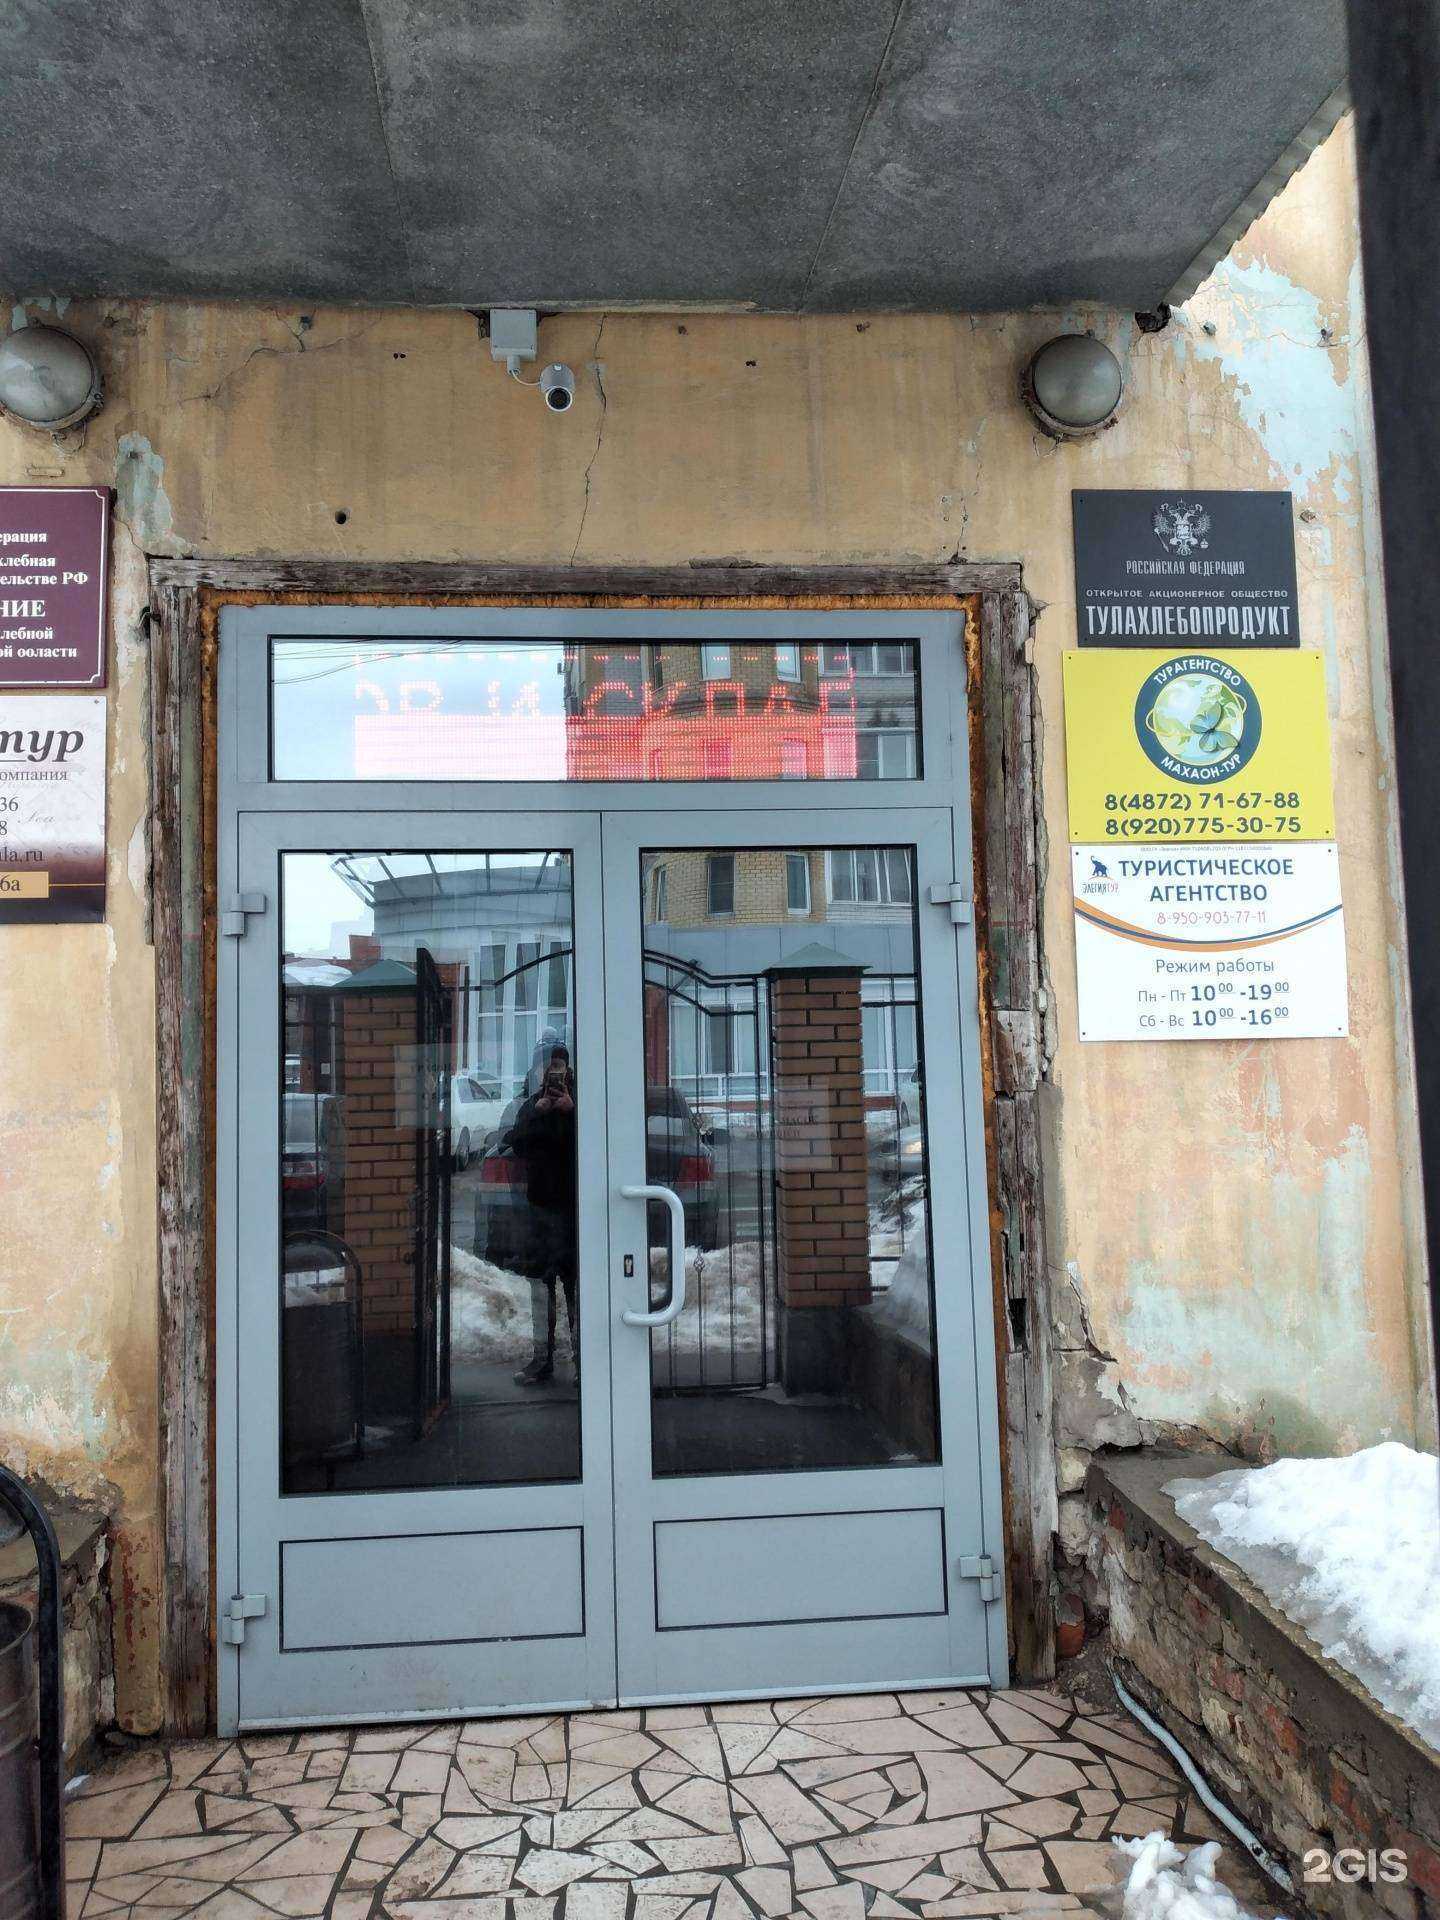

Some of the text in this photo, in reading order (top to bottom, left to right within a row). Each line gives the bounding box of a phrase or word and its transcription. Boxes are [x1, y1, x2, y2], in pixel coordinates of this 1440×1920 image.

[1126, 559, 1245, 576] РОССИЙСКАЯ ФЕДЕРАЦИЯ
[62, 572, 88, 585] РФ
[1086, 589, 1288, 599] ОТКРЫТОЕ АКЦИОНЕРНОЕ ОБЩЕСТВО
[1085, 606, 1290, 639] ТУЛАХЛЕБОПРОДУКТ
[1153, 659, 1242, 687] ТУРАГЕНТСТВО
[1160, 753, 1242, 780] МАХАОН-ТУР
[1199, 792, 1300, 810] 71-67-88
[1105, 817, 1302, 836] 8(920)775-30-75
[0, 846, 43, 863] la.ru
[1118, 858, 1294, 877] ТУРИСТИЧЕСКОЕ
[1150, 884, 1268, 902] АГЕНТСТВО
[1157, 911, 1266, 925] 8-950-903-77-11
[1156, 959, 1275, 976] Режим работы
